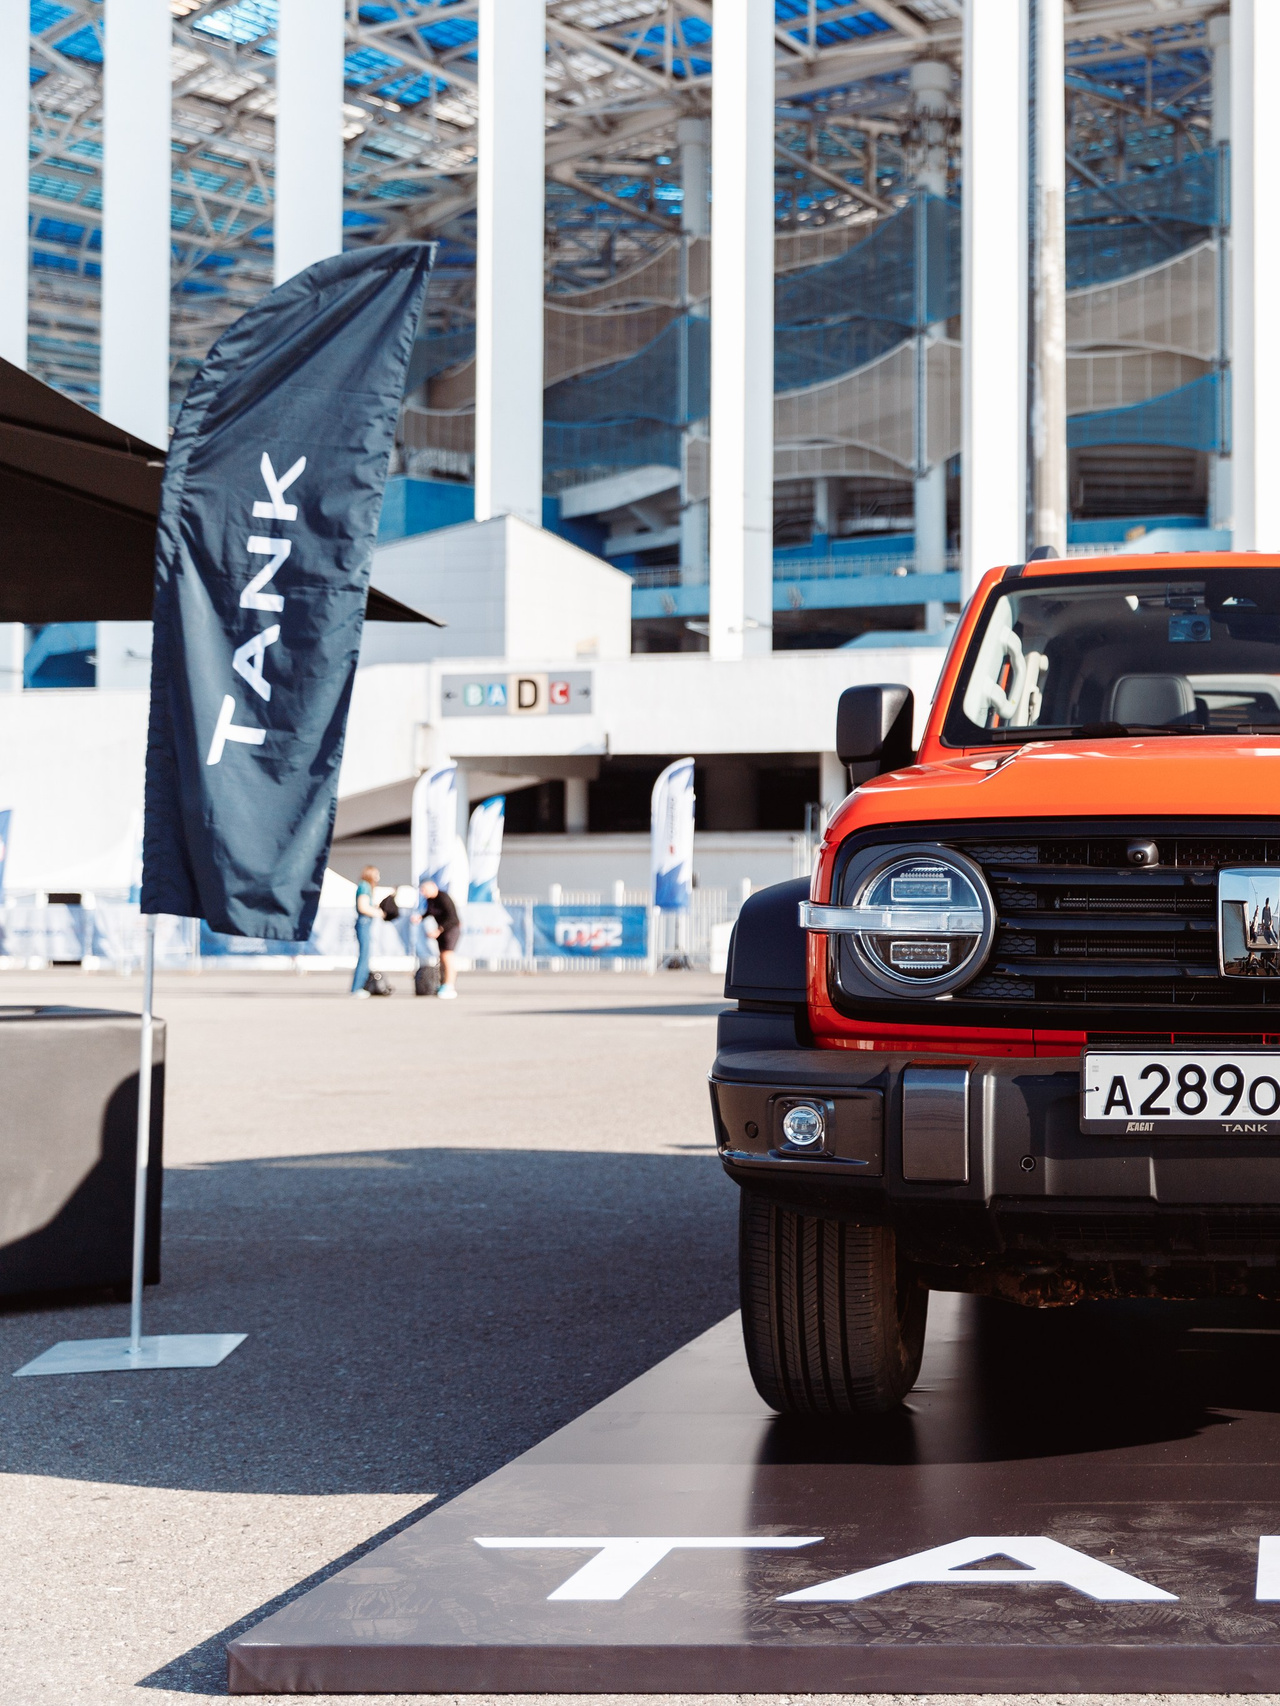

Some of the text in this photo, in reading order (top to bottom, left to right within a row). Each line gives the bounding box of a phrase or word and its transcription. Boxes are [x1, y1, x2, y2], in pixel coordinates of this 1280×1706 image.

[206, 451, 307, 766] TANK
[518, 679, 537, 708] D
[1222, 1123, 1268, 1132] TANK
